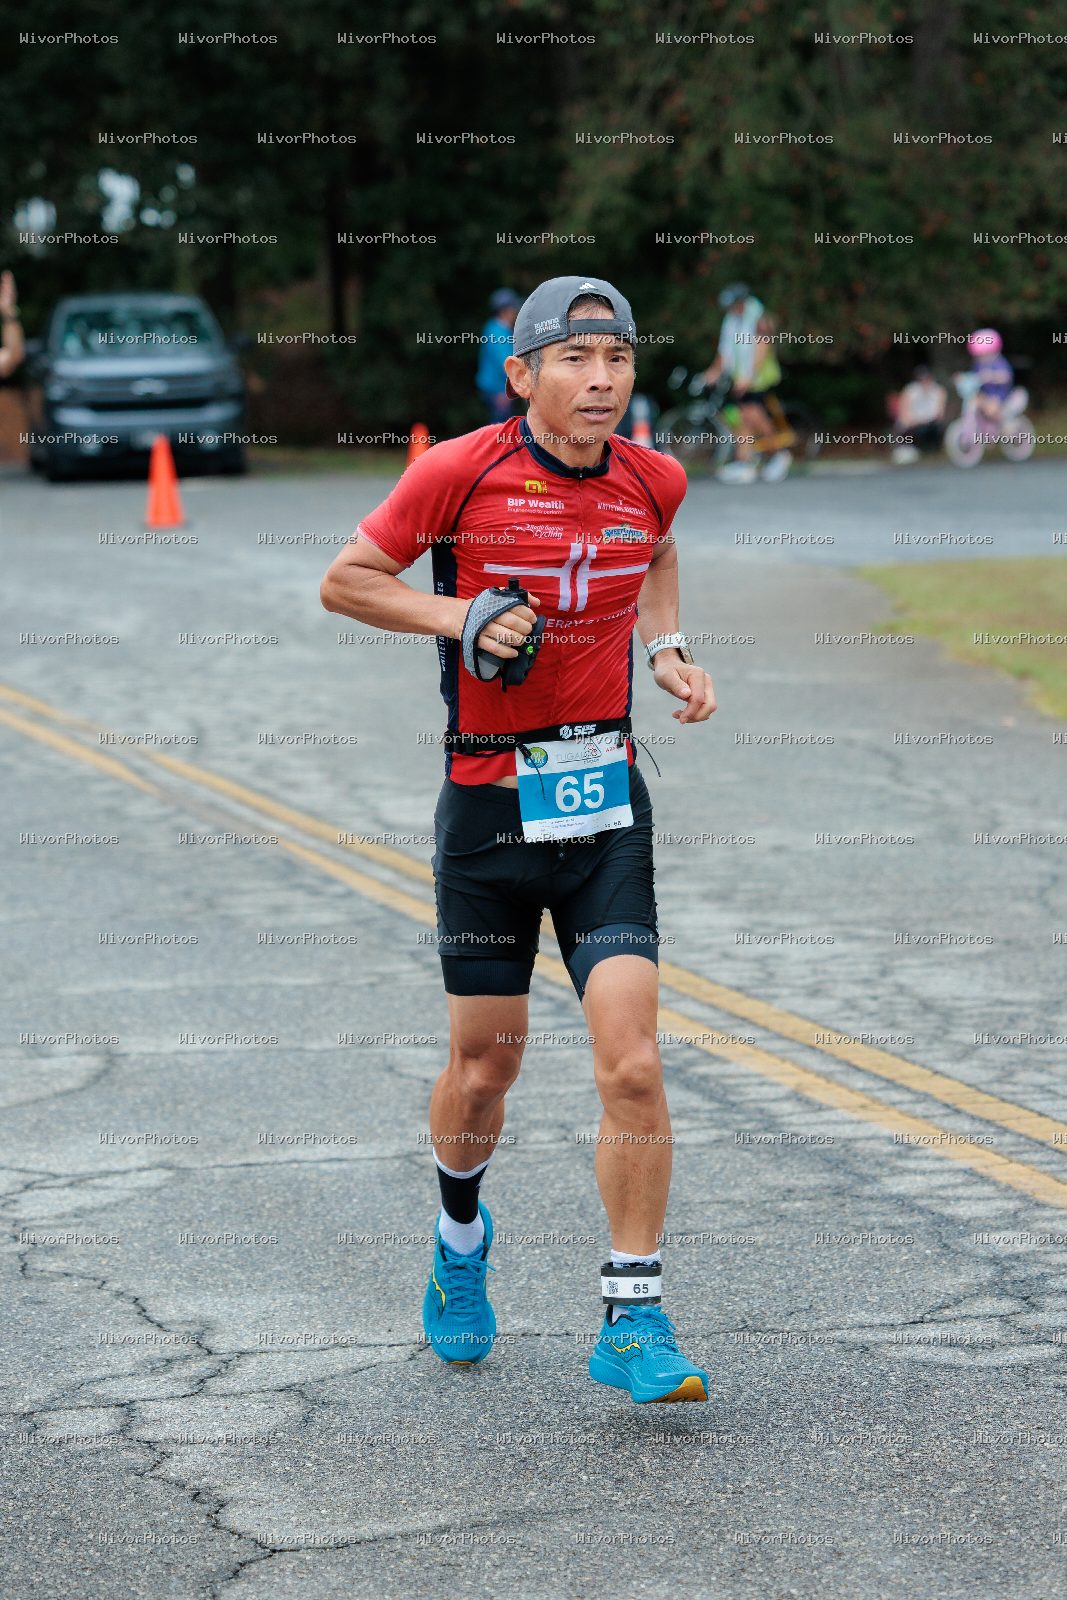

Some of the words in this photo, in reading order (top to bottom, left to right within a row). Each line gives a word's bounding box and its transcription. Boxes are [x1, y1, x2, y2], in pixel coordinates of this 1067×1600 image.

[507, 498, 526, 507] BIP
[528, 499, 565, 510] Wealth
[534, 529, 563, 540] Cycling
[555, 771, 605, 813] 65
[633, 1283, 649, 1294] 65
